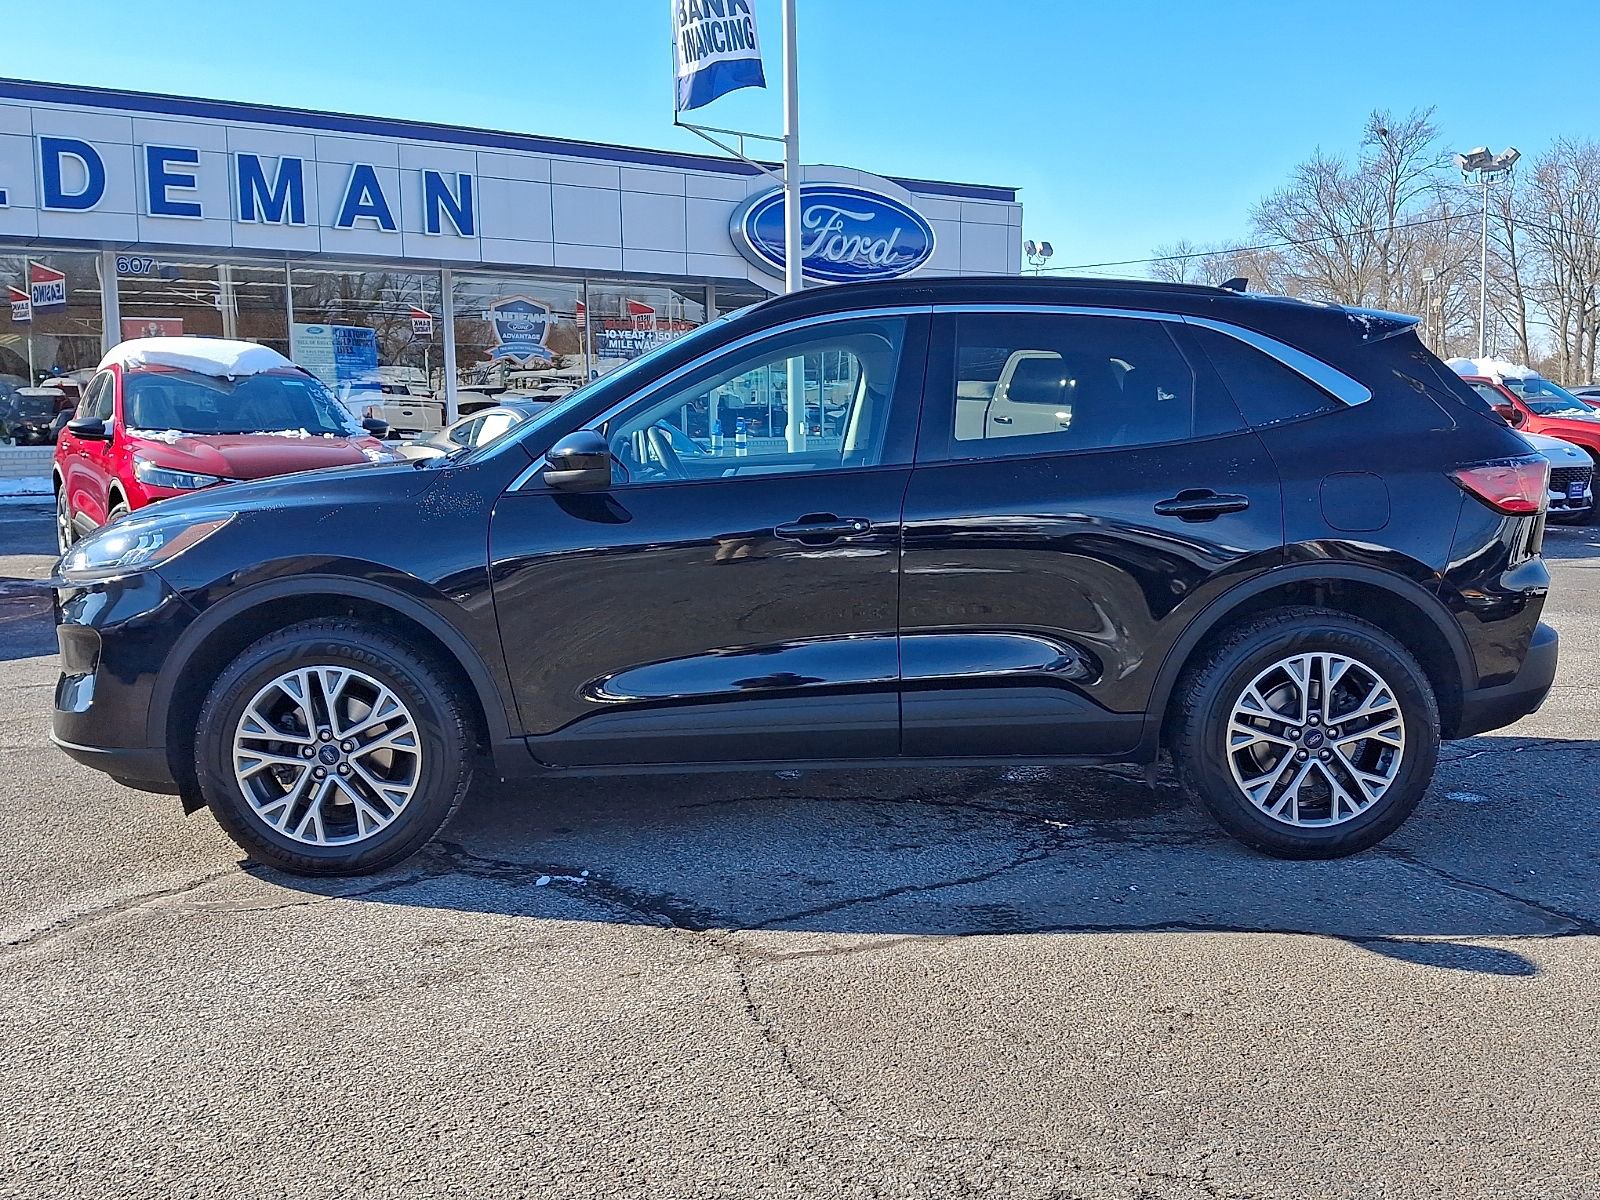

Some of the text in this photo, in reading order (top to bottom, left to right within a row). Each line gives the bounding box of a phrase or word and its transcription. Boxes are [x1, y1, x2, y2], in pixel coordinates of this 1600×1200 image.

[681, 16, 756, 64] INANCING
[0, 134, 477, 238] DEMAN
[801, 205, 902, 265] Ford
[115, 256, 153, 274] 607
[604, 330, 618, 339] 10
[618, 330, 645, 340] YEAR
[609, 340, 633, 349] MILE
[326, 644, 427, 705] GOODYEAR
